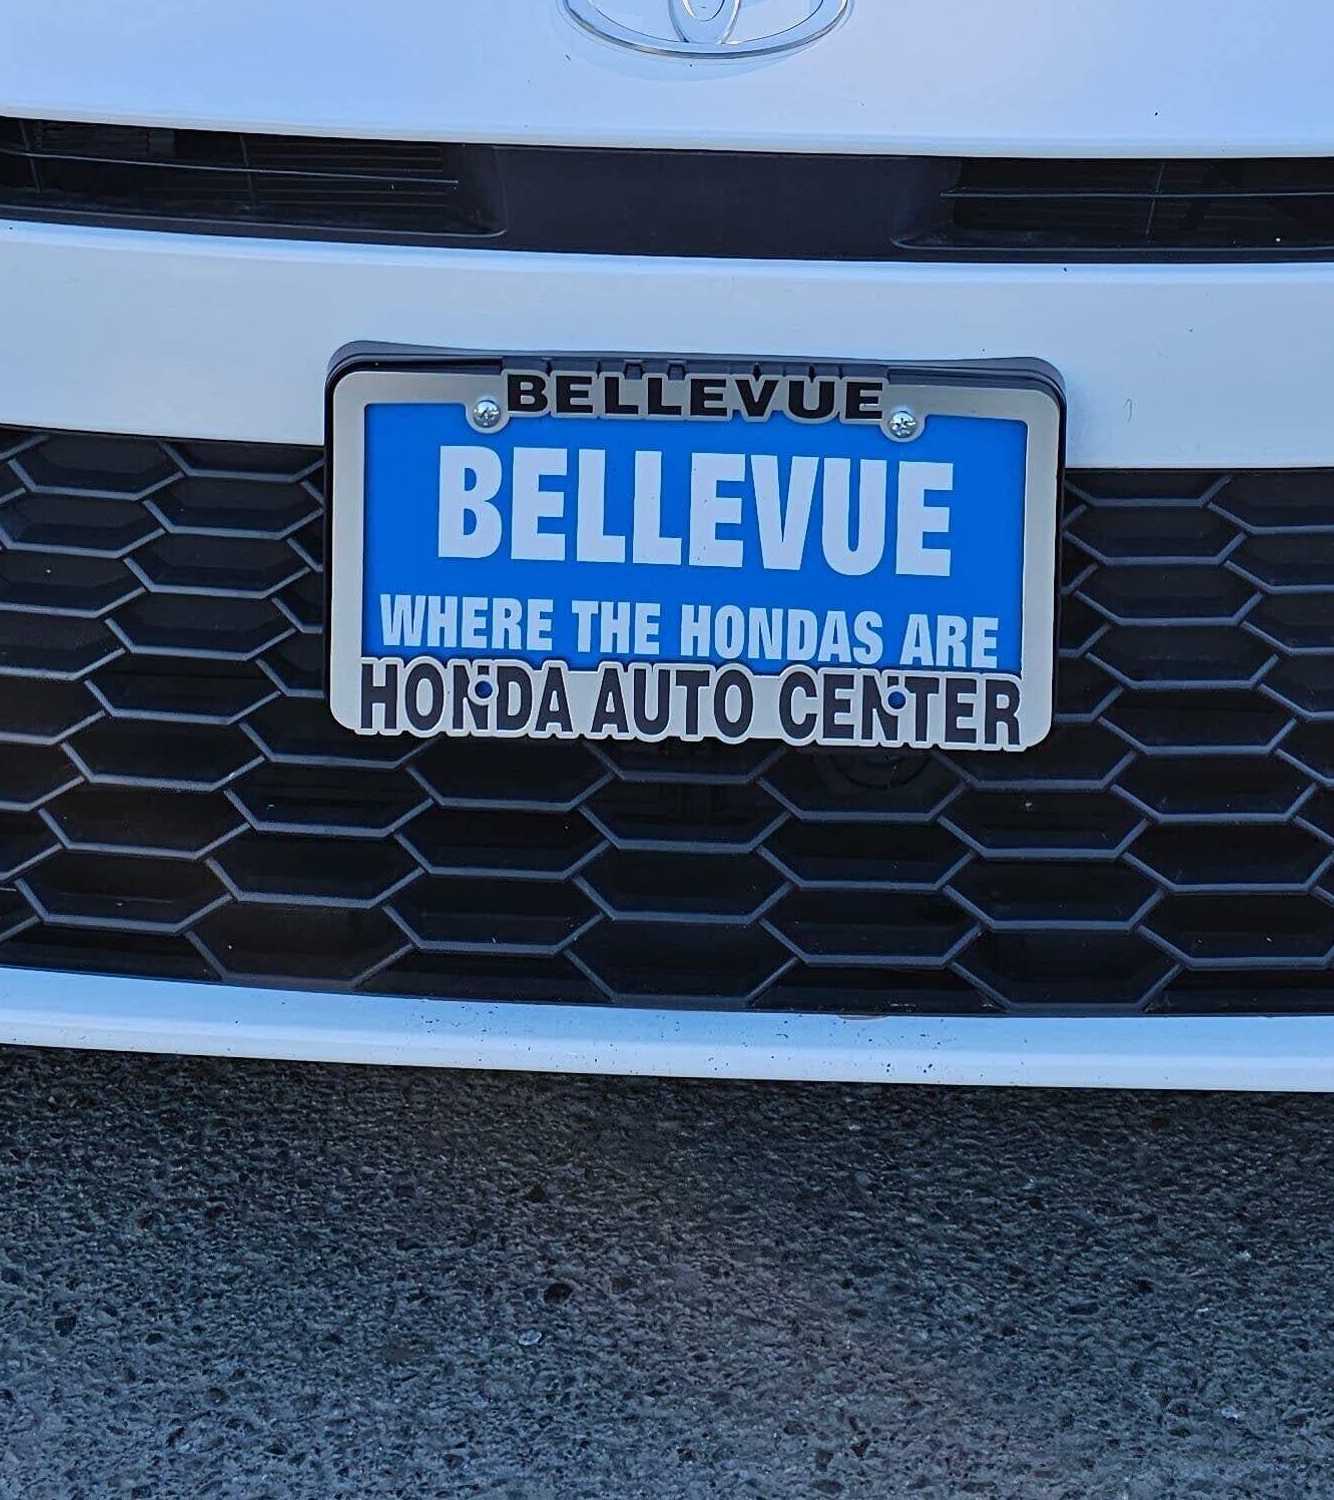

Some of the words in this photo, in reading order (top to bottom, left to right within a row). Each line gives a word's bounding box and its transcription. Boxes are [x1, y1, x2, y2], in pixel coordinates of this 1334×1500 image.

[507, 373, 883, 418] BELLEVUE
[438, 445, 954, 577] BELLEVUE
[380, 593, 554, 651] WHERE
[572, 600, 660, 655] THE
[680, 603, 884, 664] HONDAS
[899, 614, 1000, 669] ARE
[362, 662, 571, 732] HONDA
[592, 668, 753, 741] AUTO
[779, 674, 1021, 746] CENTER
